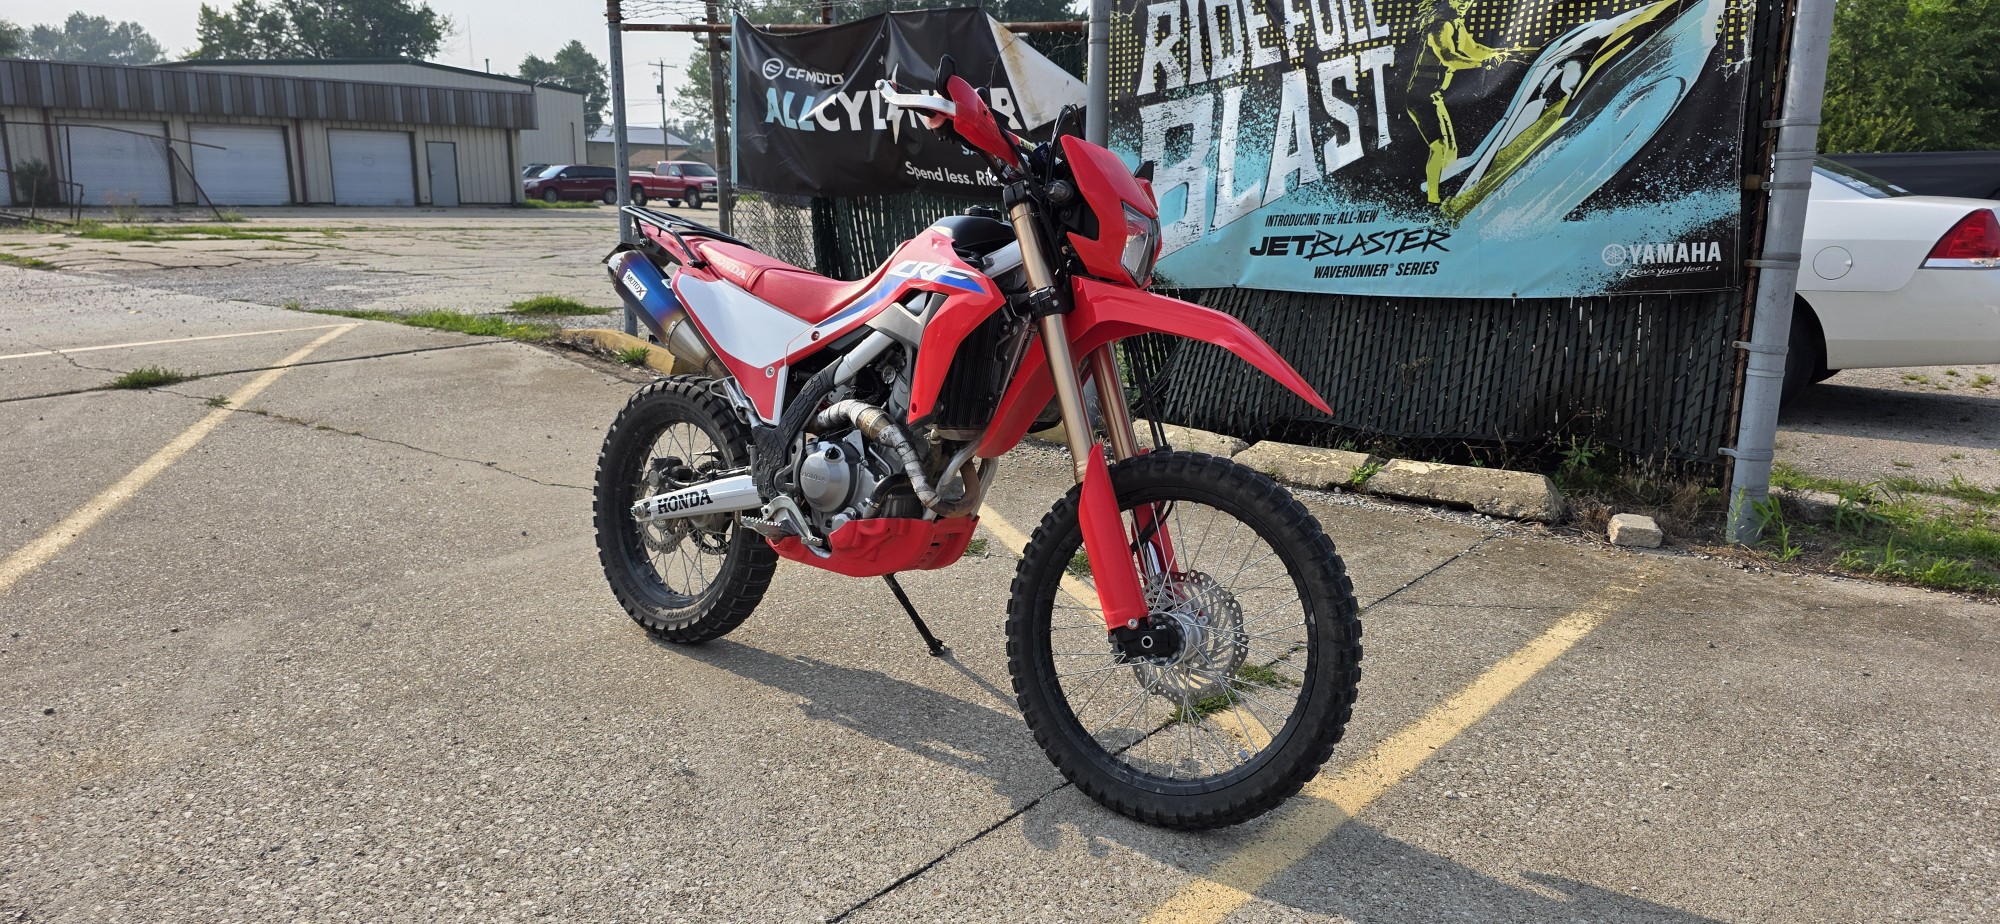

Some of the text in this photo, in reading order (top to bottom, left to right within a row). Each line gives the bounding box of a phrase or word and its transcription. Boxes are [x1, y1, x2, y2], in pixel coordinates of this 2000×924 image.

[785, 67, 844, 85] CFMOTO
[1139, 45, 1395, 260] BLAST
[905, 161, 943, 182] Spend
[945, 168, 974, 185] less.
[1265, 210, 1379, 228] INTRODUCING THE ALL-NEW
[1628, 241, 1722, 265] YAMAHA
[708, 250, 747, 280] HONDA
[888, 260, 982, 281] CRF
[1395, 261, 1440, 276] SERIES
[1620, 268, 1655, 279] Revs
[1655, 267, 1681, 278] Your
[657, 488, 714, 515] HONDA
